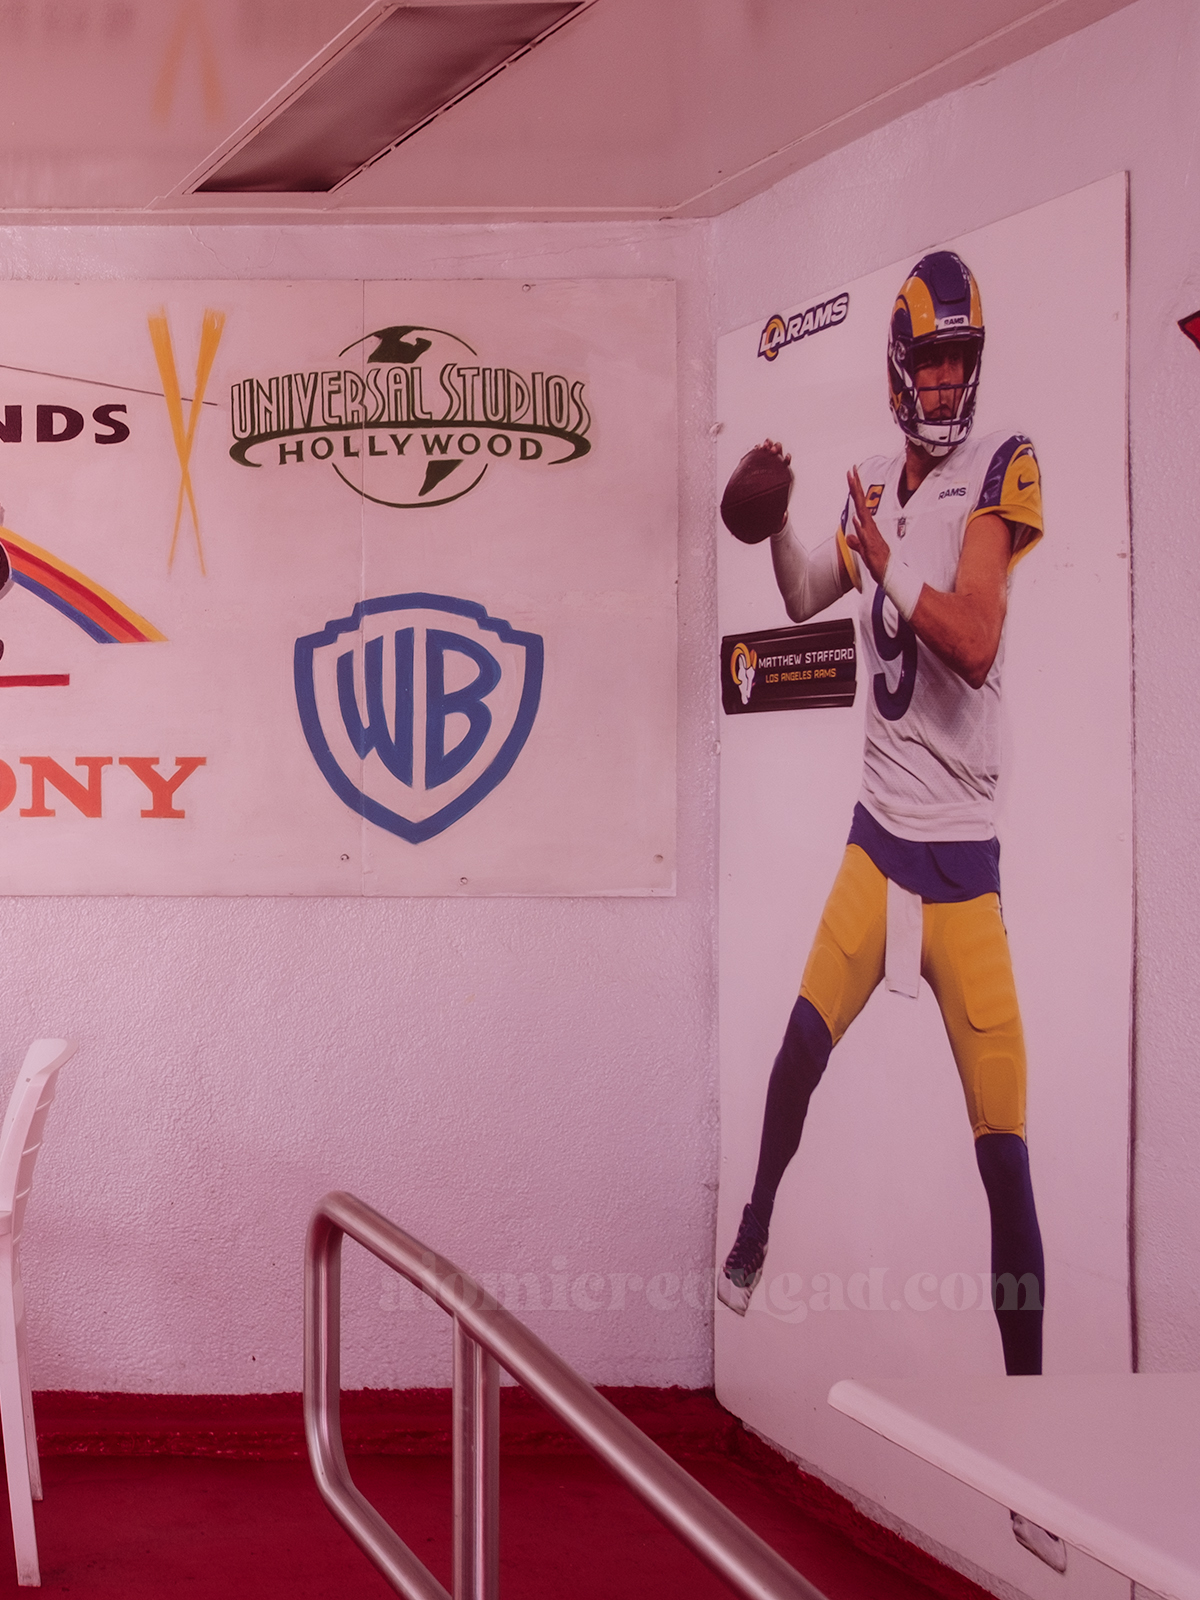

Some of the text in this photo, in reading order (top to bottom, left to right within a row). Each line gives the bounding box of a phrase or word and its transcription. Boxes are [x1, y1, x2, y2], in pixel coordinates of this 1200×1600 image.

[785, 292, 849, 342] RAMS
[231, 362, 591, 440] UNIVERSAL STUDIOS
[278, 432, 544, 464] HOLLYWOOD
[938, 487, 966, 500] RAMS
[758, 648, 854, 669] MATTHEW STAFFORD
[871, 584, 918, 721] 9
[765, 667, 837, 683] LOS ANGELES RAMS
[336, 626, 502, 790] WB
